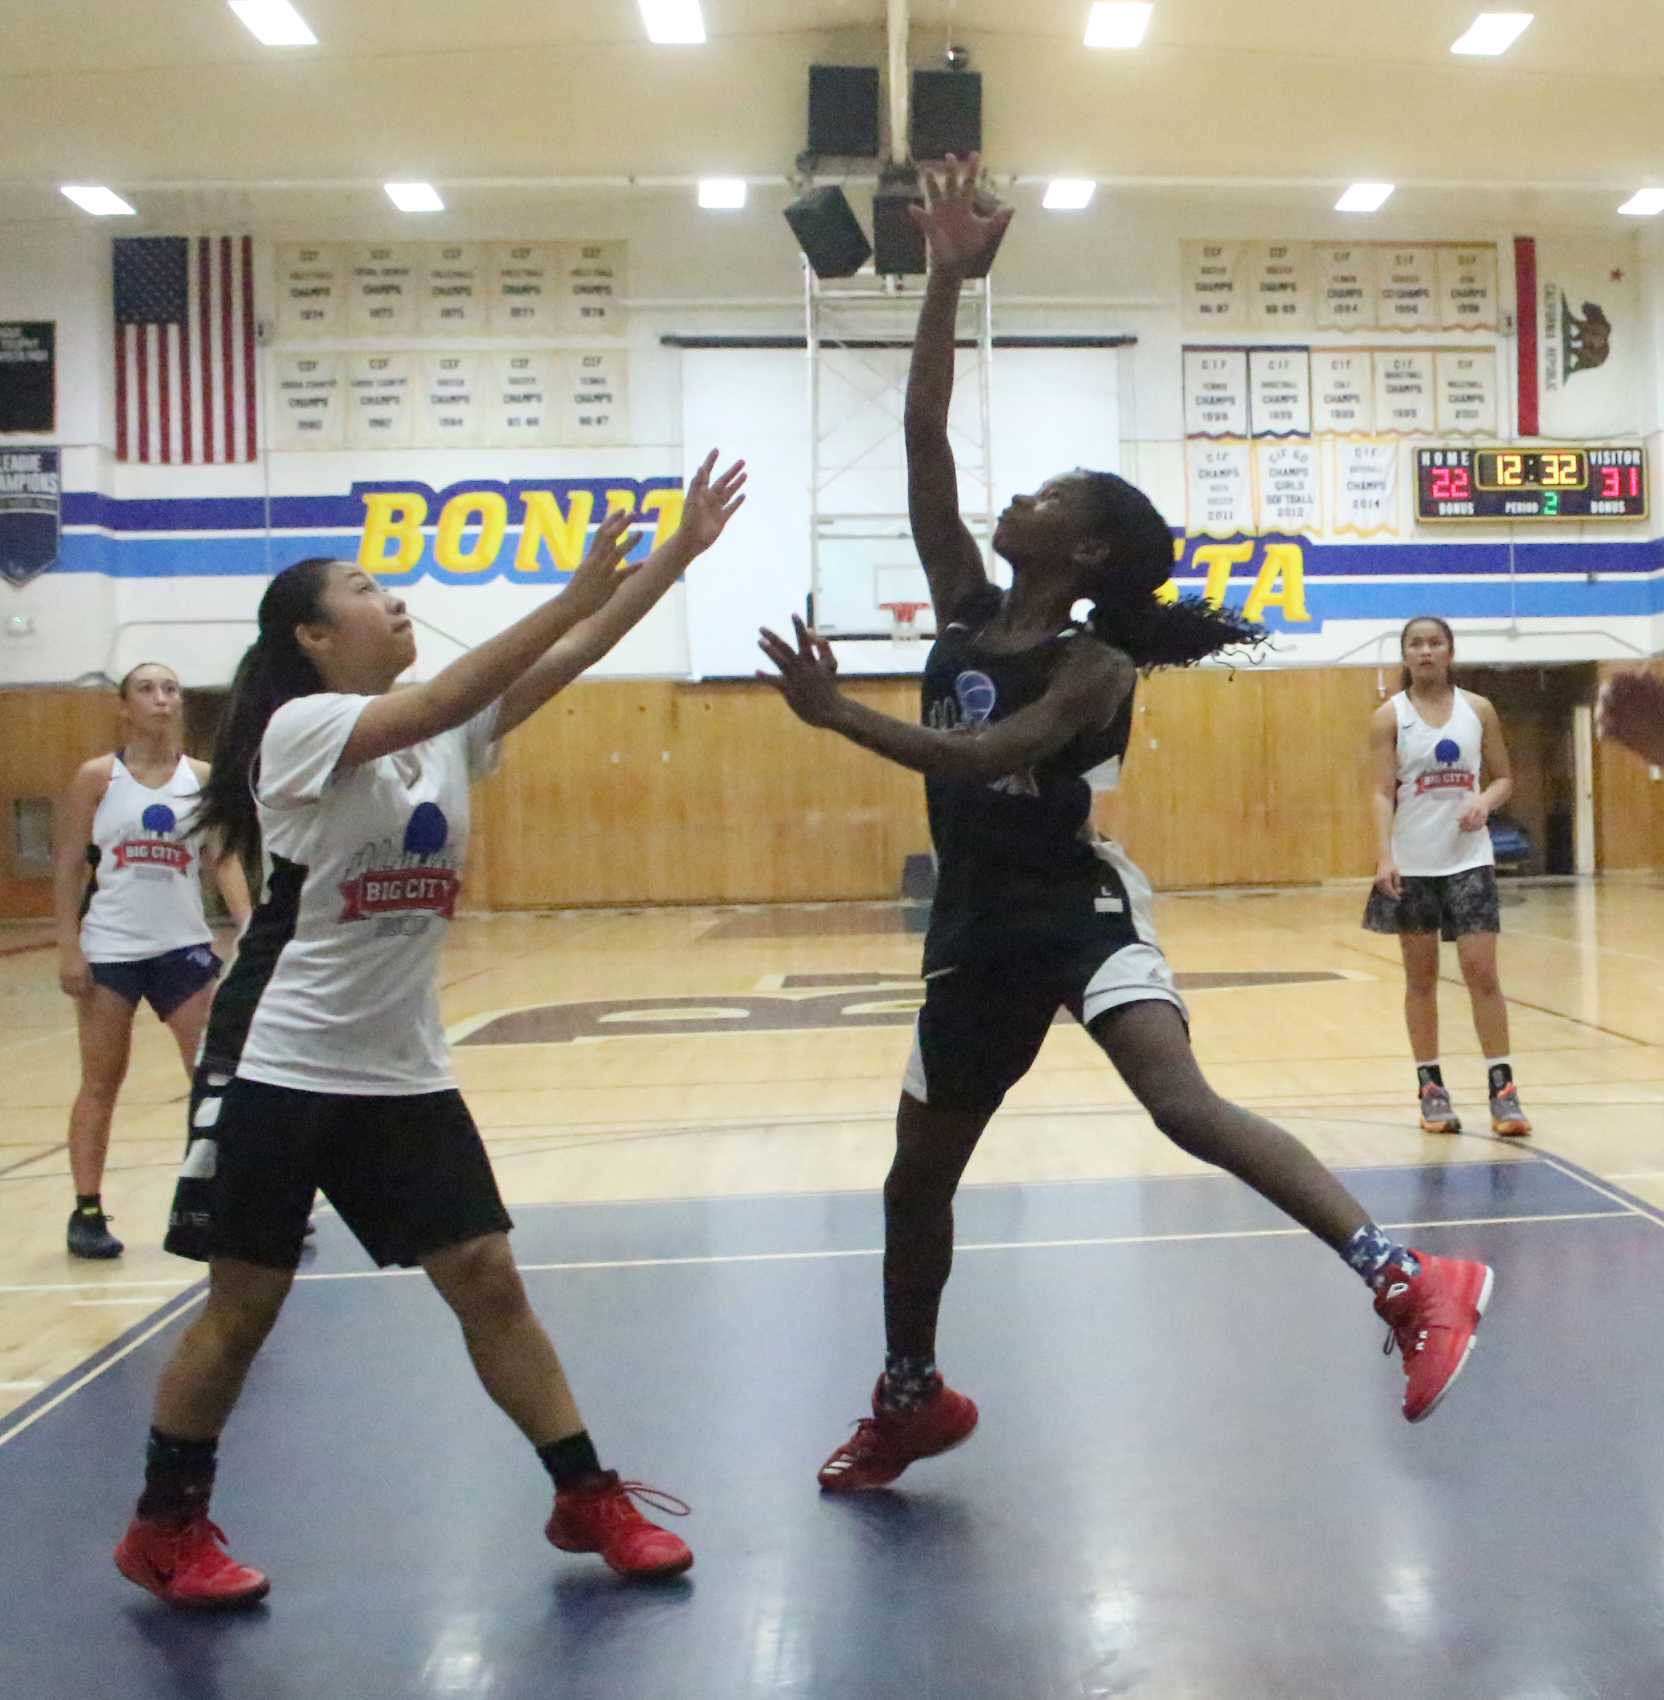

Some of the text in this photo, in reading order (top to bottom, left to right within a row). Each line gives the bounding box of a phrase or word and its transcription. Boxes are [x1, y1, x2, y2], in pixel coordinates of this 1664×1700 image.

[1395, 254, 1414, 265] CIF
[1458, 254, 1476, 265] CIF
[290, 286, 331, 298] CHAMPS
[362, 284, 402, 296] CHAMPS
[432, 285, 472, 297] CHAMPS
[502, 284, 541, 295] CHAMPS
[573, 284, 612, 296] CHAMPS
[1195, 282, 1233, 292] CHAMPS
[1260, 282, 1297, 293] CHAMPS
[1327, 288, 1363, 298] CHAMPS
[1451, 288, 1486, 298] CHAMPS
[369, 358, 389, 370] CIF
[439, 358, 460, 370] CIF
[511, 358, 530, 369] CIF
[582, 356, 602, 367] CIF
[1201, 360, 1227, 369] CIF
[1268, 361, 1289, 370] CIF
[1331, 360, 1350, 369] CIF
[1394, 360, 1412, 369] CIF
[1458, 360, 1474, 369] CIF
[1386, 384, 1422, 394] CHAMPS
[289, 398, 328, 408] CHAMPS
[360, 395, 400, 406] CHAMPS
[430, 394, 470, 405] CHAMPS
[503, 393, 542, 404] CHAMPS
[574, 393, 612, 404] CHAMPS
[1195, 396, 1235, 406] CHAMPS
[1262, 395, 1298, 404] CHAMPS
[1324, 394, 1360, 403] CHAMPS
[1449, 394, 1485, 403] CHAMPS
[1206, 453, 1229, 463] CIF
[1268, 449, 1287, 464] CIF
[1355, 447, 1378, 458] CIF
[1590, 451, 1641, 464] VISITOR
[1421, 451, 1470, 466] HOME
[1198, 468, 1240, 478] CHAMPS
[1269, 468, 1309, 477] CHAMPS
[1497, 455, 1577, 485] 12:32
[0, 472, 58, 494] AMPIONS
[1275, 481, 1305, 490] GIRLS
[1347, 481, 1386, 491] CHAMPS
[1432, 467, 1470, 498] 22
[1601, 466, 1639, 497] 31
[1266, 495, 1314, 504] SOFTBALL
[1352, 499, 1380, 508] 2014
[1505, 491, 1558, 515] PERIOD 2
[1277, 508, 1304, 518] 2012
[1438, 502, 1475, 515] BONUS
[1591, 501, 1626, 514] BONUS
[1207, 511, 1233, 520] 2011
[126, 845, 182, 862] BIG CITY
[366, 878, 453, 902] BIG CITY
